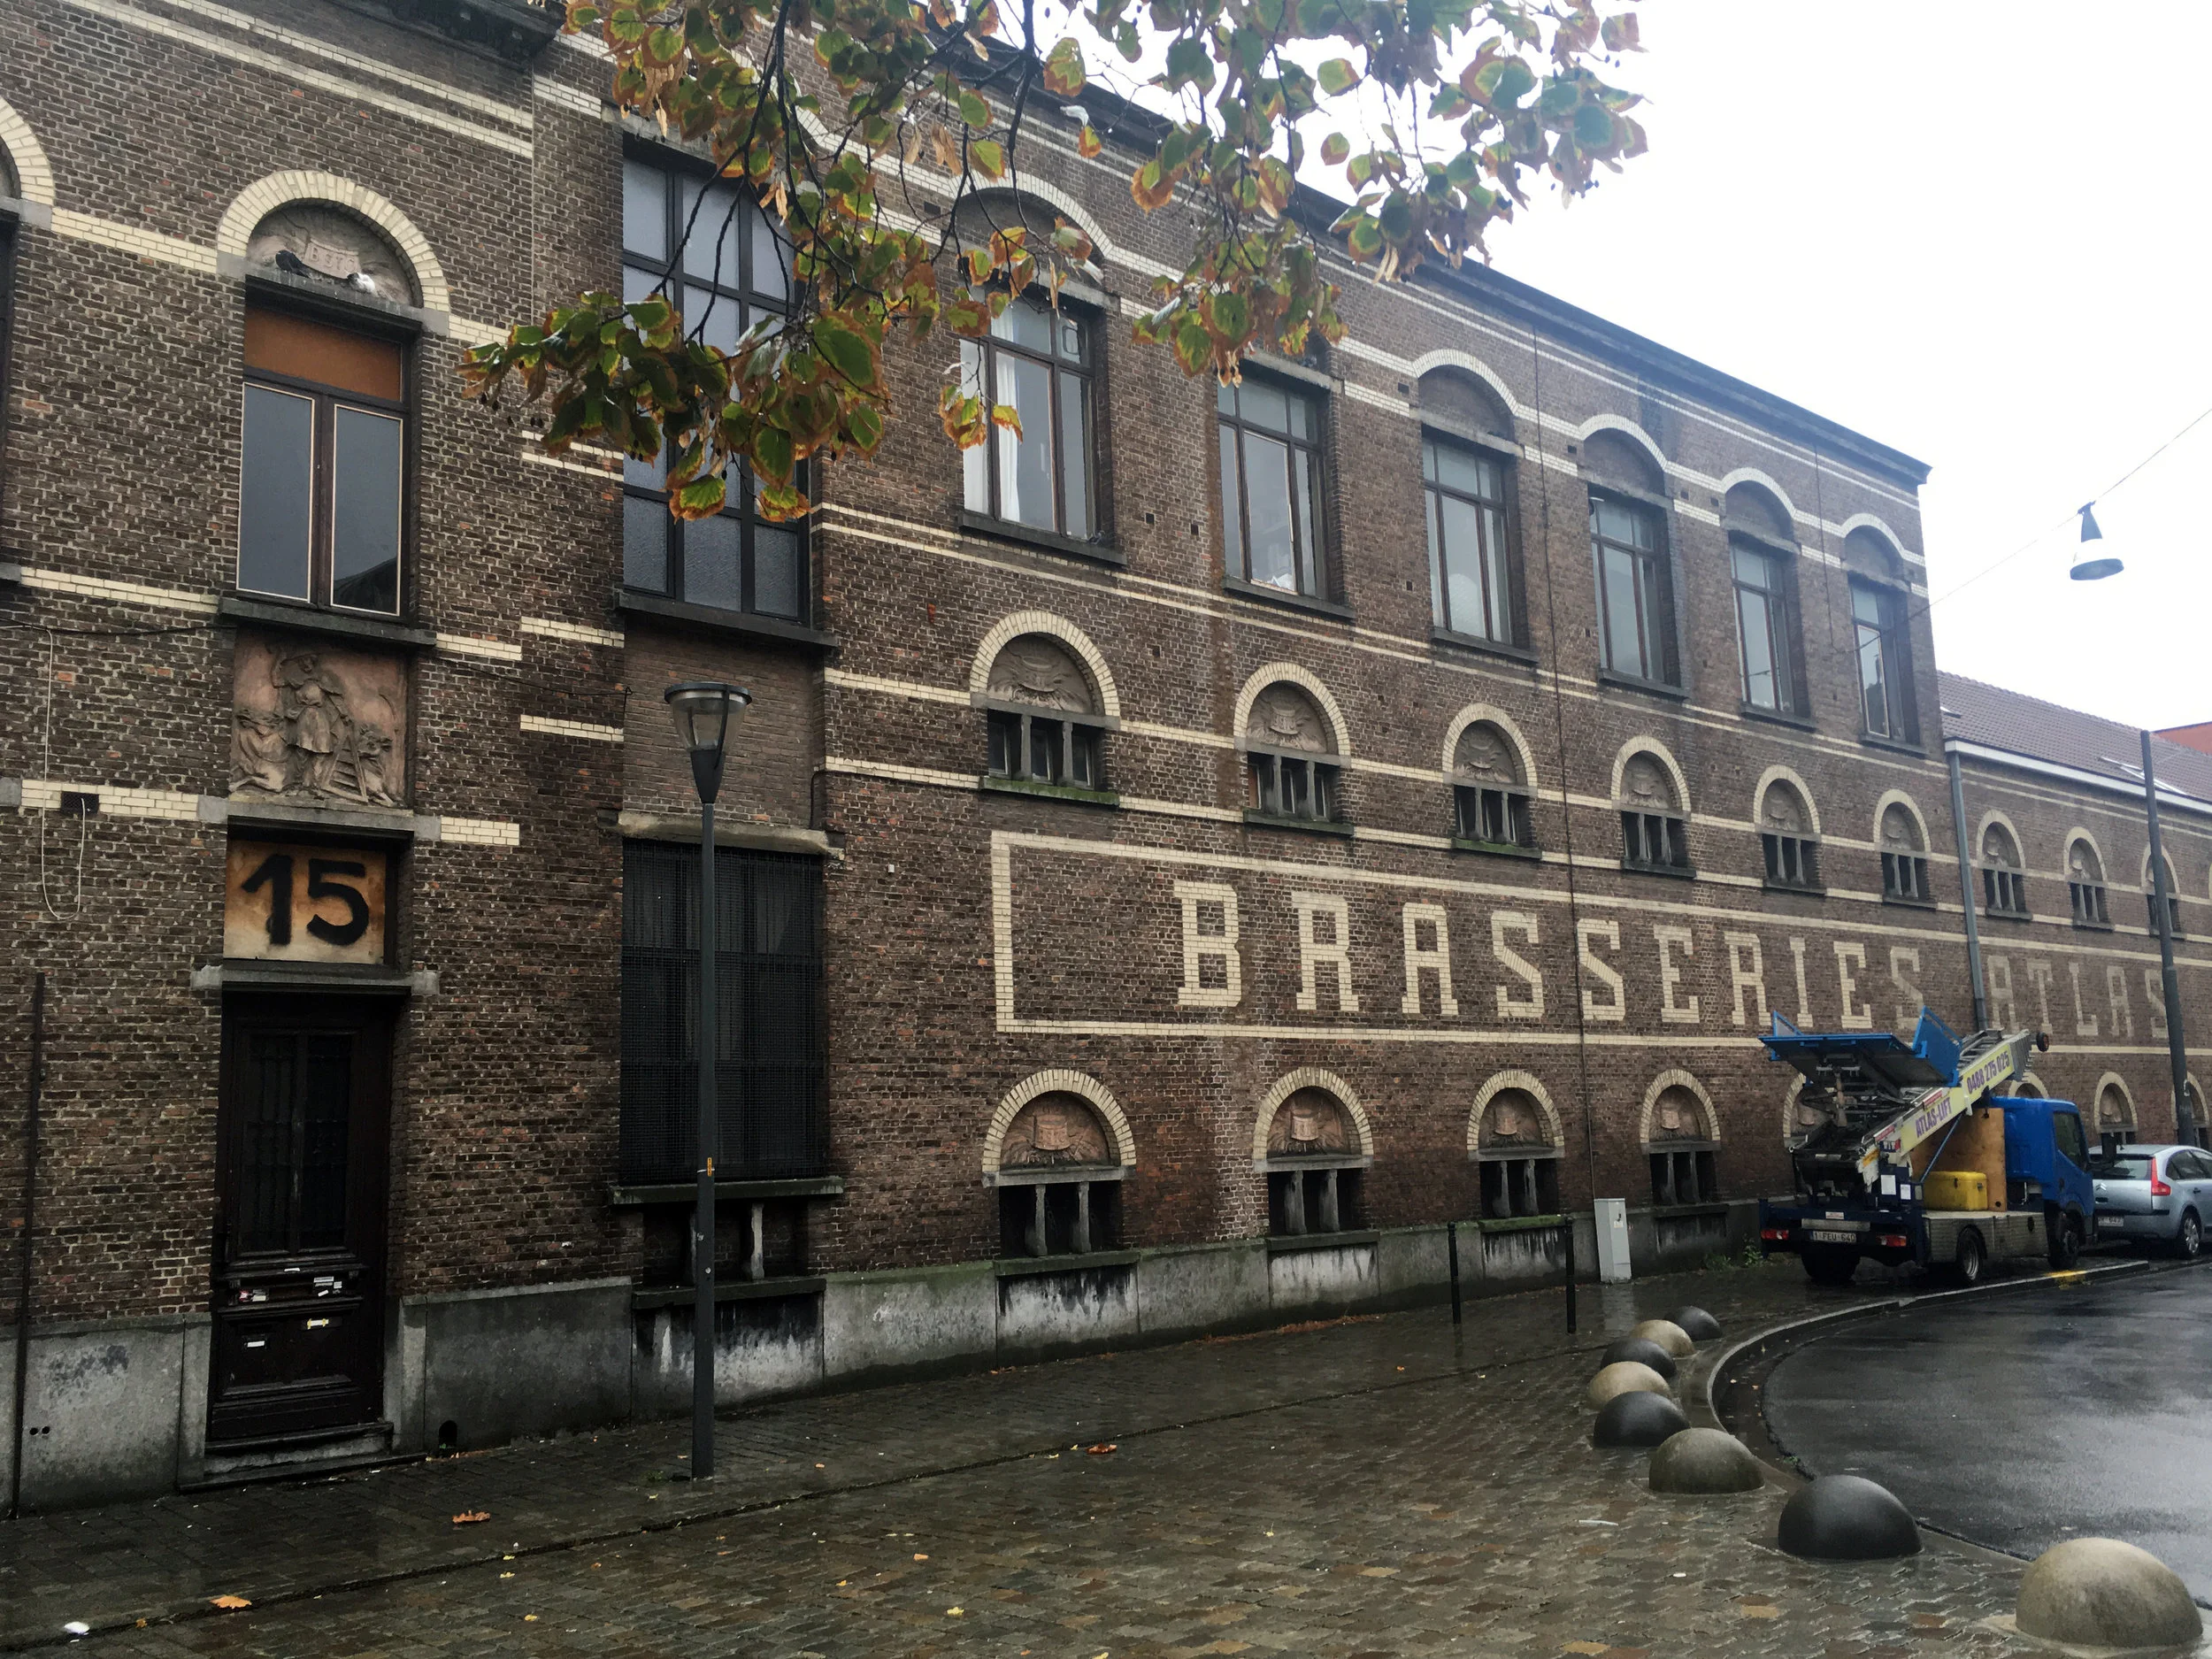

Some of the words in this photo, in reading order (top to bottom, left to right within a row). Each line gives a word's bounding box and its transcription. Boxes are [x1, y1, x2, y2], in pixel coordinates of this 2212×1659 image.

[242, 853, 368, 946] 15
[1173, 880, 1924, 1031] BRASSERIES
[1987, 955, 2169, 1038] ATLAS
[1967, 1068, 1985, 1094] 0488
[1984, 1060, 1998, 1081] 275
[1996, 1051, 2010, 1073] 025
[1915, 1096, 1952, 1138] ATLAS-LIFT
